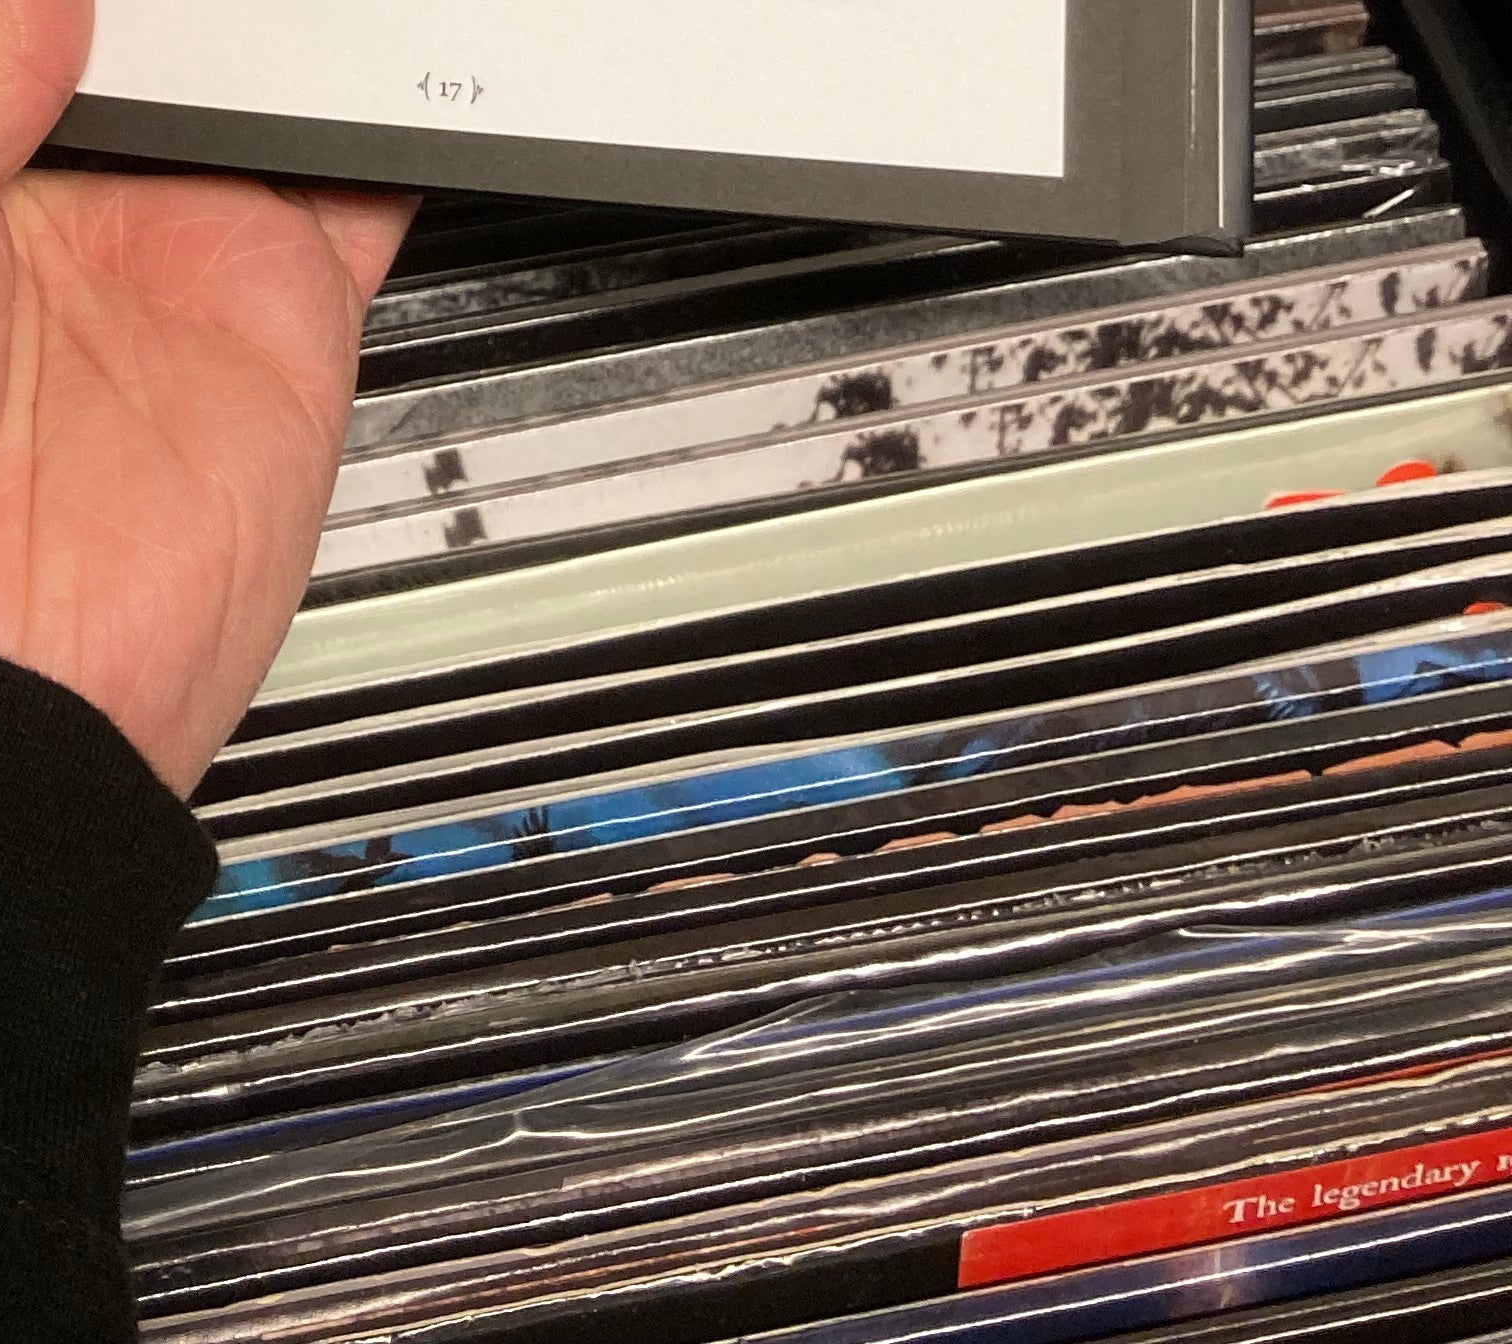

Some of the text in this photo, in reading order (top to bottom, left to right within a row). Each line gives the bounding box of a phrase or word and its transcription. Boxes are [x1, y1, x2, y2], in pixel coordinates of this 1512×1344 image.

[439, 81, 462, 101] 17
[1223, 1194, 1296, 1224] The
[1311, 1160, 1483, 1211] legendary
